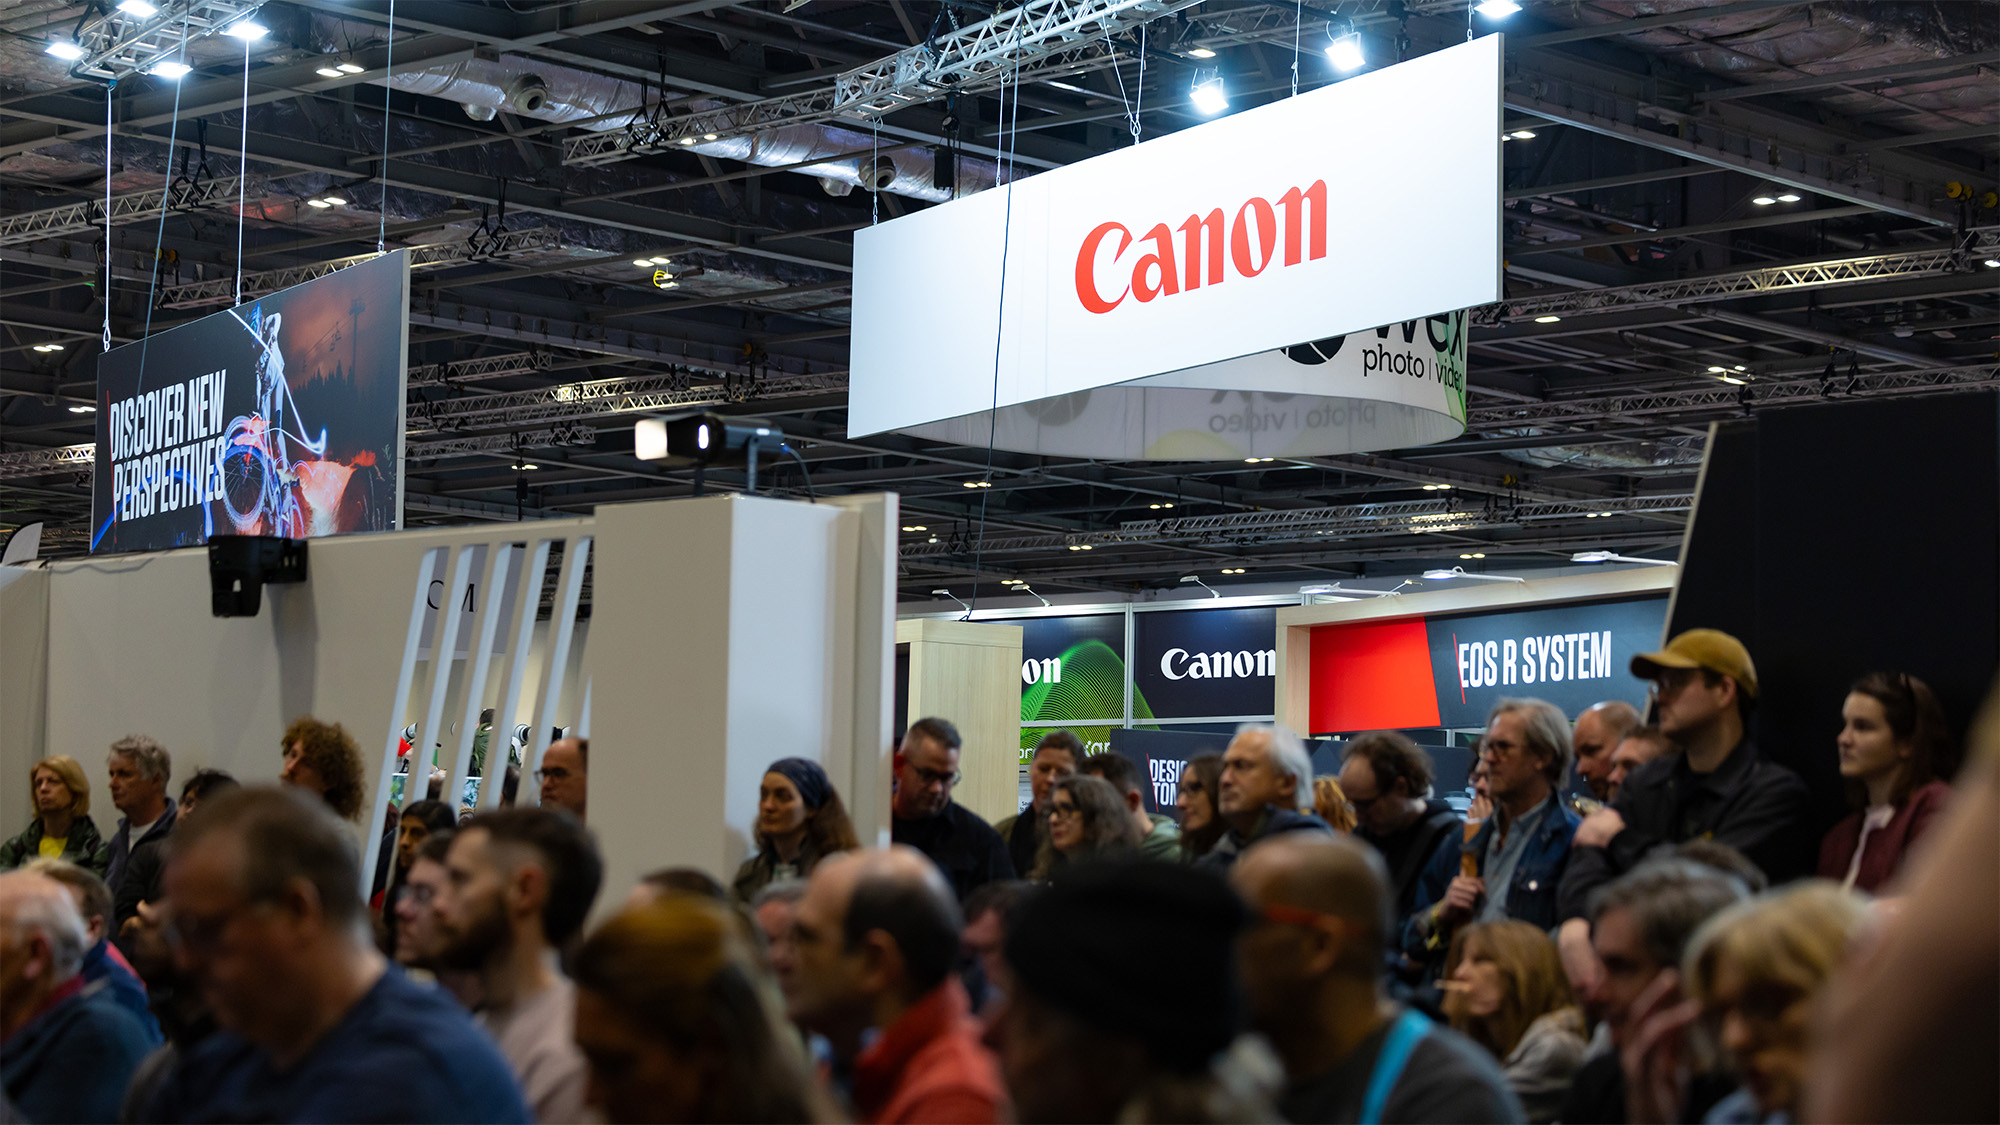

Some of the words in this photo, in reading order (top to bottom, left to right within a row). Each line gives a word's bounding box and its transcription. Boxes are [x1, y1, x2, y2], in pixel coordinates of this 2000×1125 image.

[1075, 179, 1327, 314] Canon
[1362, 343, 1425, 378] photo
[1435, 358, 1463, 393] video
[110, 383, 186, 462] DISCOVER
[187, 369, 227, 442] NEW
[113, 436, 227, 523] PERSPECTIVES
[1160, 648, 1276, 681] Canon
[1458, 640, 1499, 688] EOS
[1502, 638, 1518, 686] R
[1521, 630, 1612, 684] SYSTEM
